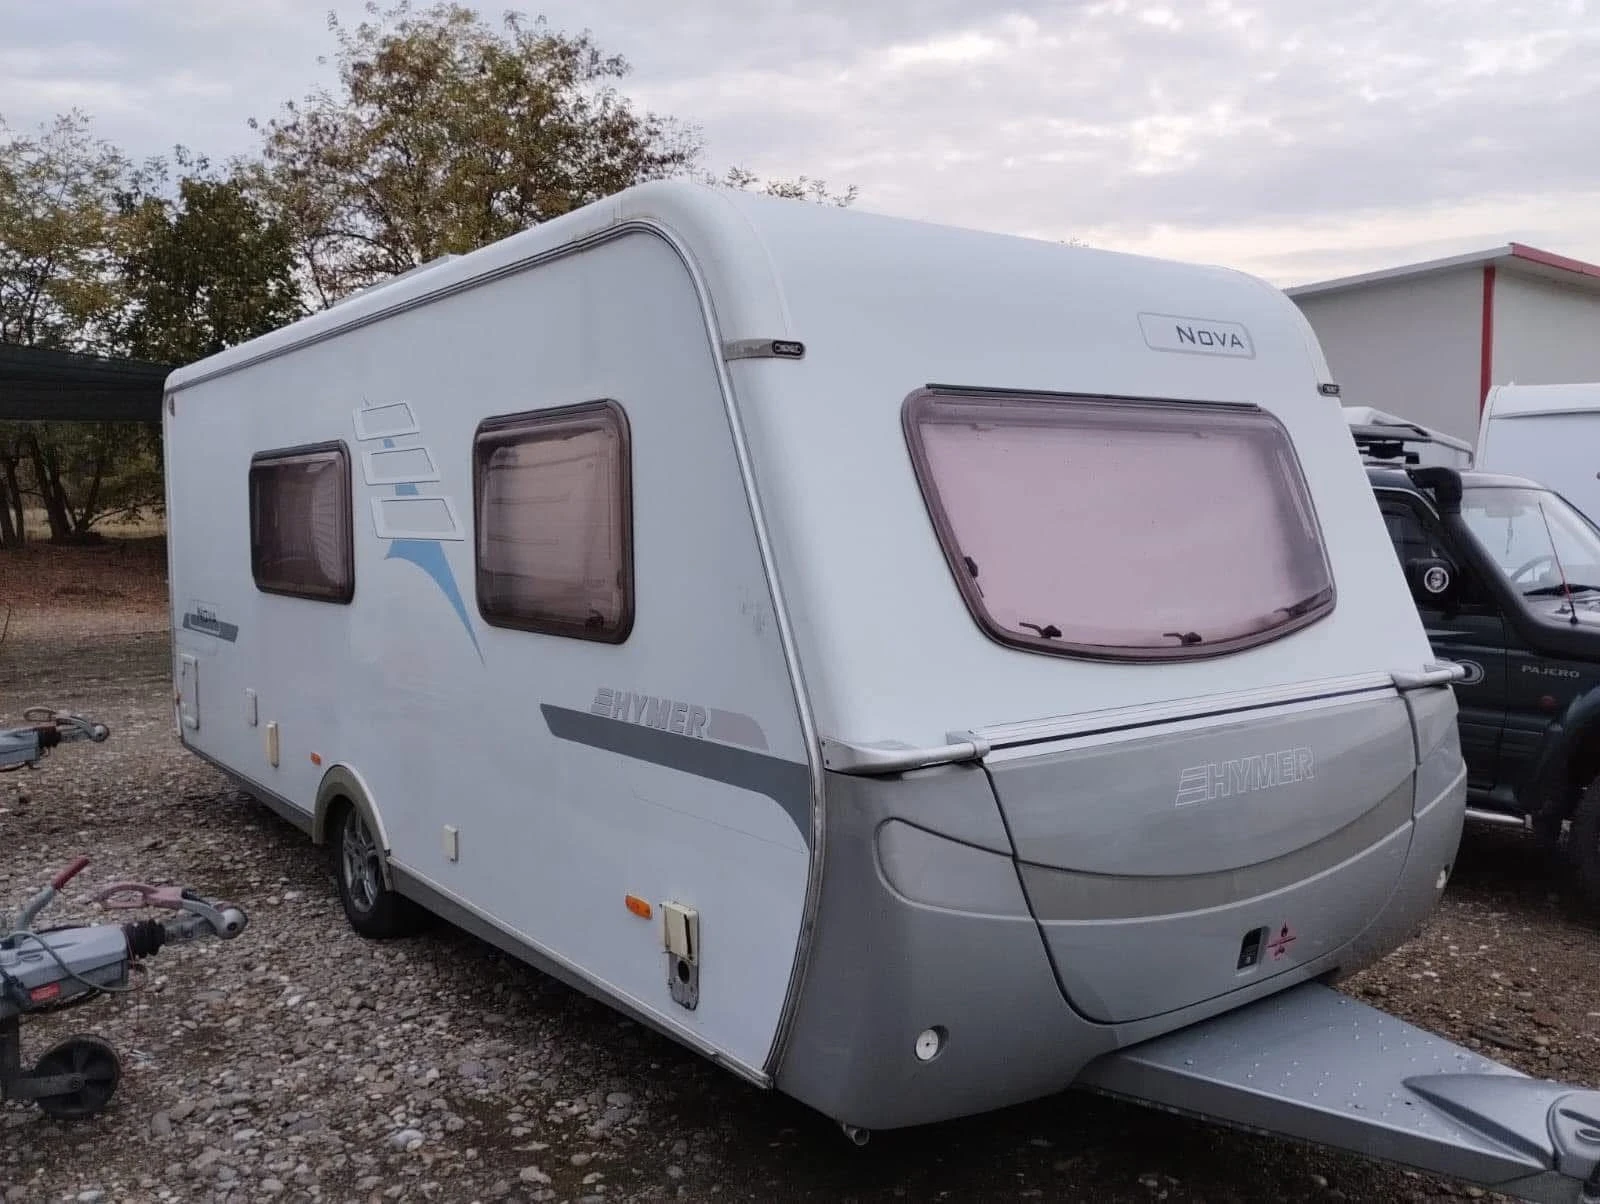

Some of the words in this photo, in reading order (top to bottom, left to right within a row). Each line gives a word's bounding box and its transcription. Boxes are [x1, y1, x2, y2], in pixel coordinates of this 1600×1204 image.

[1175, 325, 1245, 349] NOVA
[1521, 664, 1580, 678] PAJERO
[1207, 746, 1315, 800] HYMER
